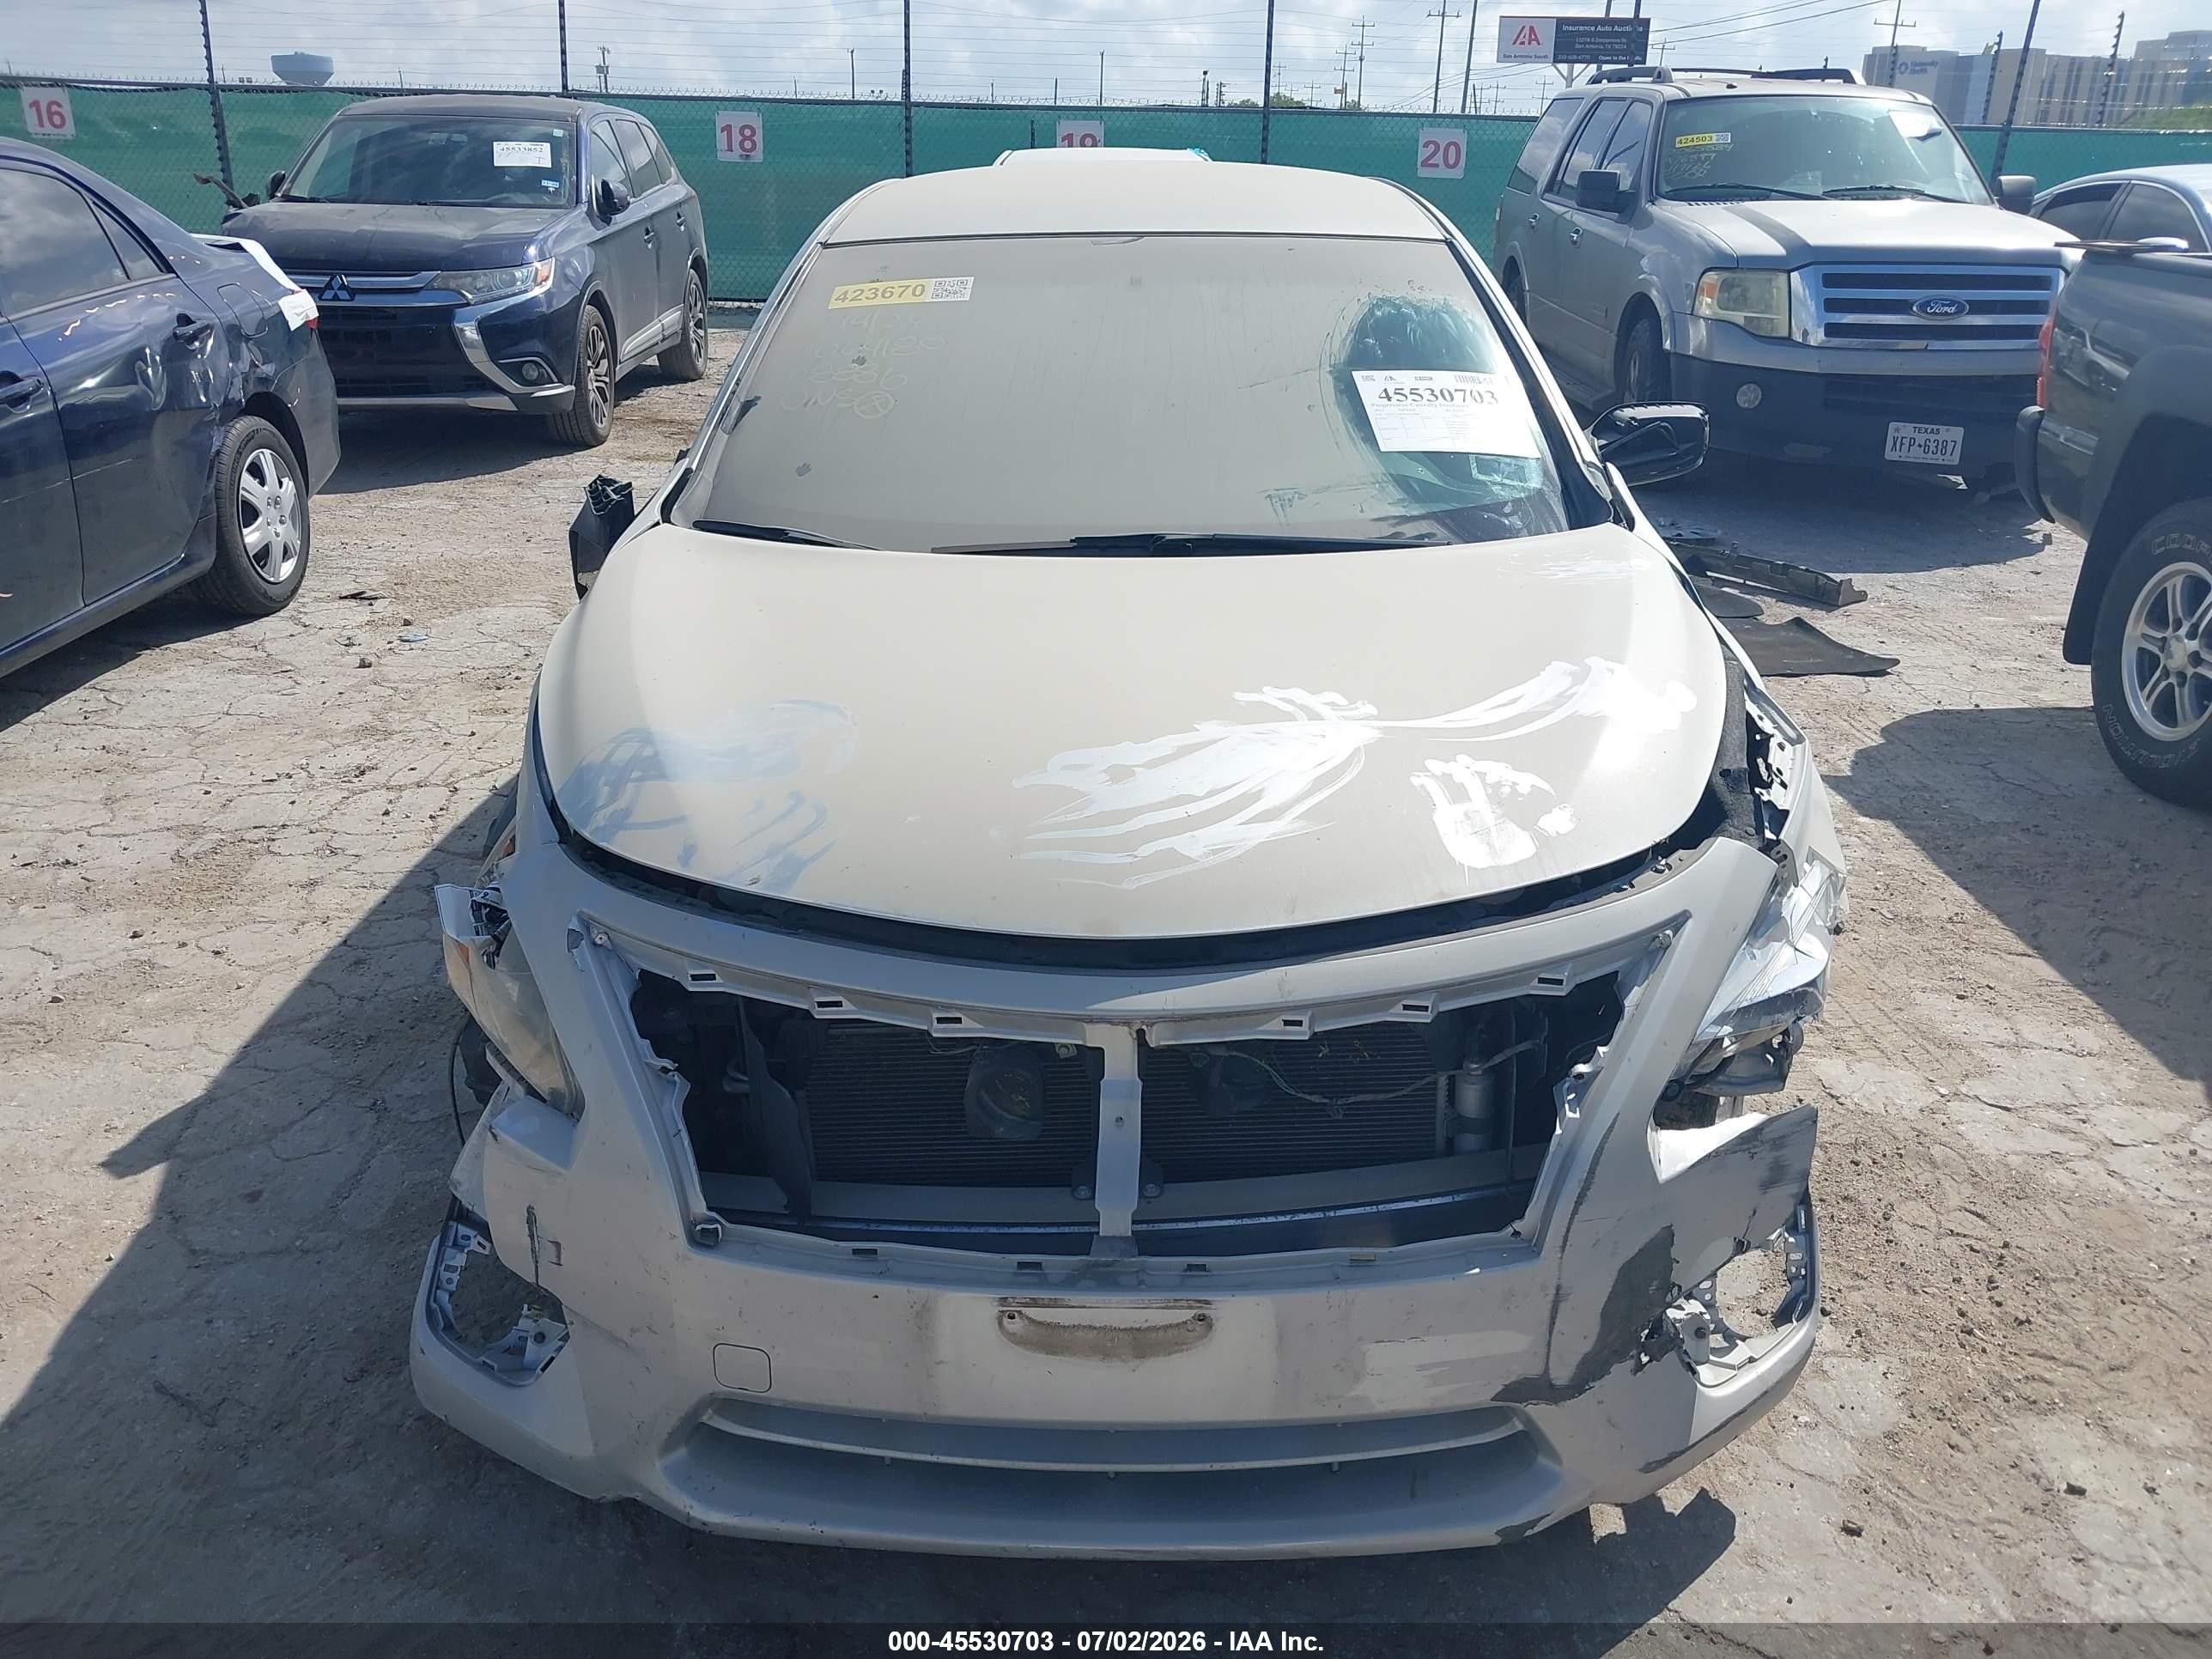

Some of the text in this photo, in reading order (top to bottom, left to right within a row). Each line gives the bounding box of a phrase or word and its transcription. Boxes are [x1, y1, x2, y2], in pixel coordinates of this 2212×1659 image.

[28, 99, 67, 130] 16
[720, 123, 757, 153] 18
[1676, 135, 1713, 145] 424503
[1420, 139, 1462, 169] 20
[834, 283, 926, 303] 423670
[1926, 300, 1958, 313] Ford
[1377, 386, 1499, 405] 45530703
[1911, 426, 1941, 435] TEXAS
[2151, 532, 2212, 565] COOP
